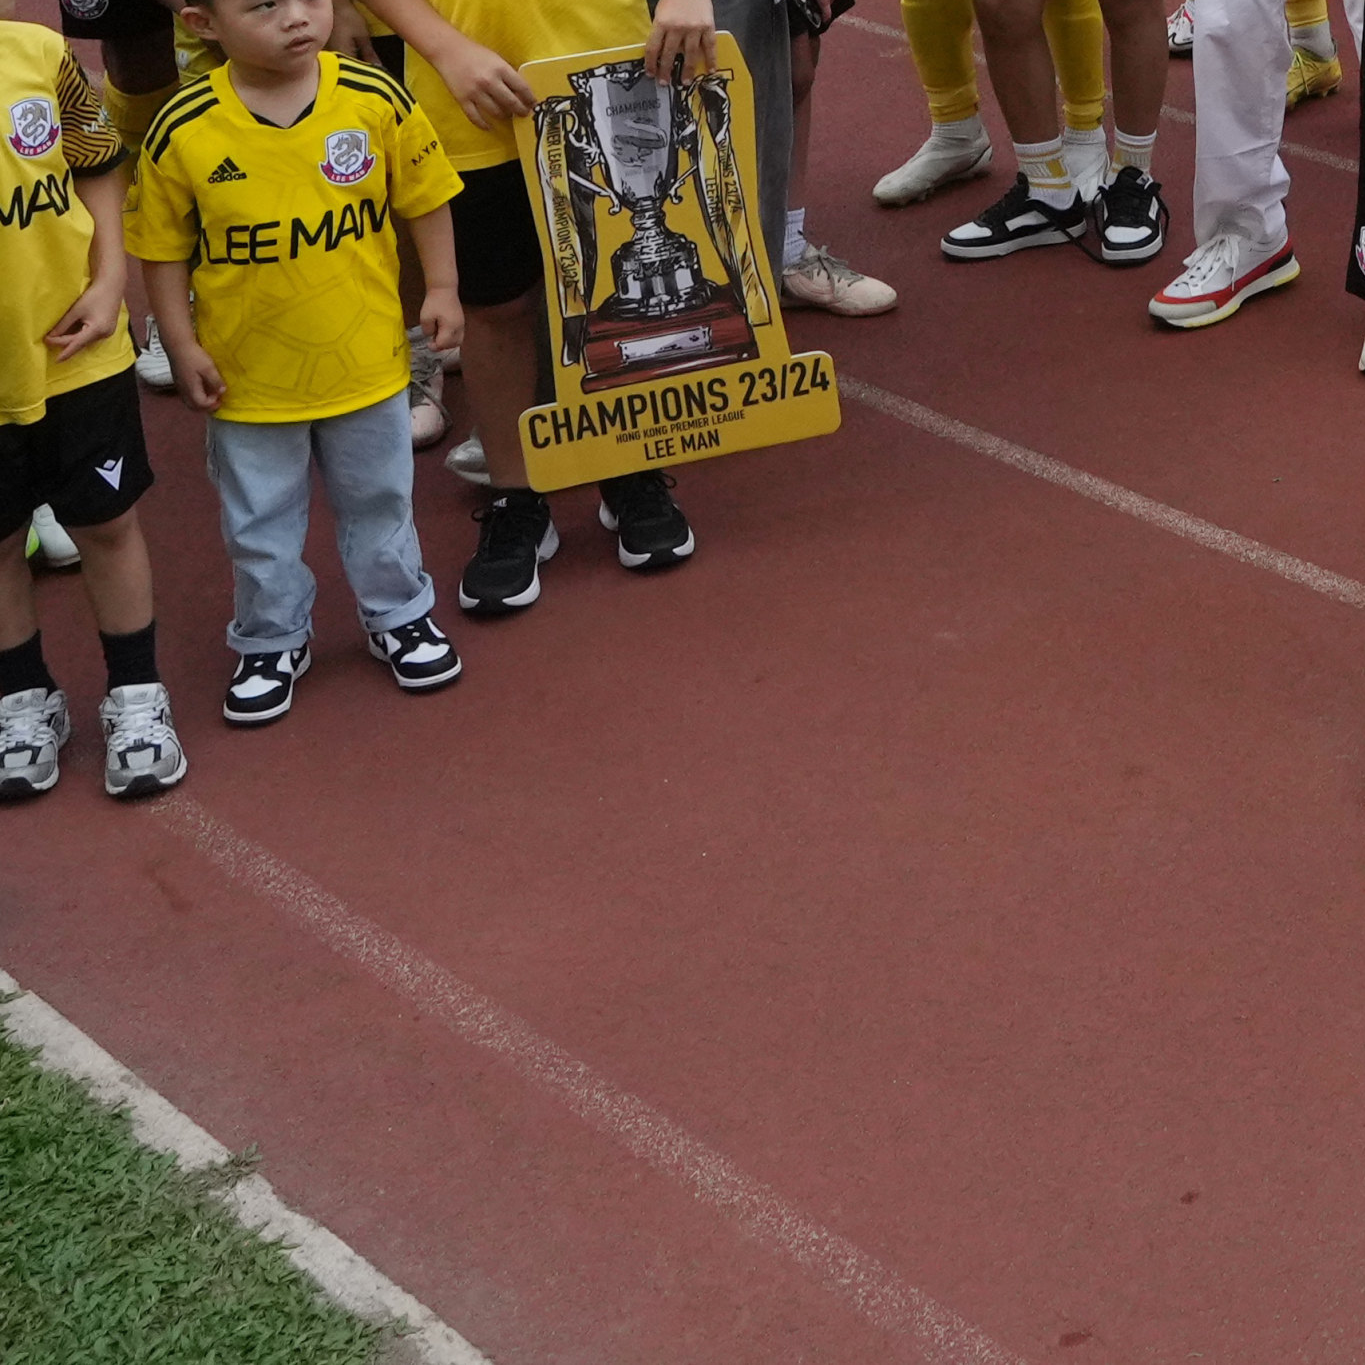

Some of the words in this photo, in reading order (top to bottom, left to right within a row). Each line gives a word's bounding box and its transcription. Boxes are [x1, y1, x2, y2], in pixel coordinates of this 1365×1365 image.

[605, 98, 662, 117] CHAMPIONS
[19, 144, 36, 156] LEE
[35, 138, 53, 154] MAN
[207, 171, 248, 185] adidas
[329, 173, 346, 183] LEE
[349, 169, 367, 182] MAN
[201, 221, 281, 268] LEE
[288, 197, 389, 261] MAN
[528, 378, 730, 449] CHAMPIONS
[740, 357, 830, 408] 23/24
[616, 428, 642, 444] HONG
[643, 424, 669, 441] KONG
[669, 416, 709, 436] PREMIER
[711, 408, 746, 428] LEAGUE
[643, 437, 676, 462] LEE
[680, 429, 721, 455] MAN
